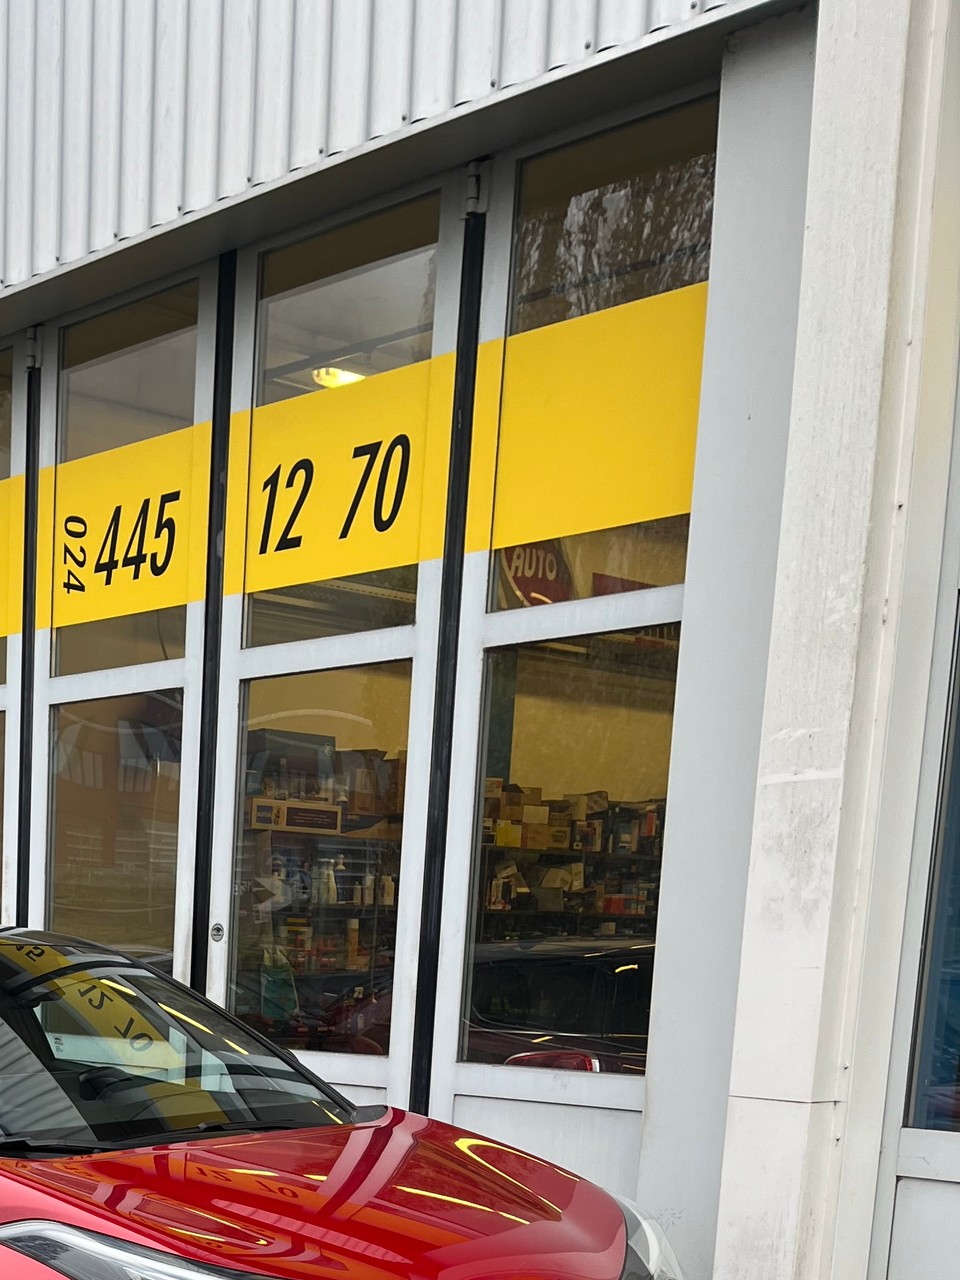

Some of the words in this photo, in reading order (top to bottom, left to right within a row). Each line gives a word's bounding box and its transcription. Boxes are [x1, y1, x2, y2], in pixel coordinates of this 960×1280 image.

[94, 490, 181, 586] 445
[258, 457, 314, 555] 12
[338, 433, 411, 540] 70
[63, 515, 88, 594] 024
[511, 548, 557, 581] AUTO
